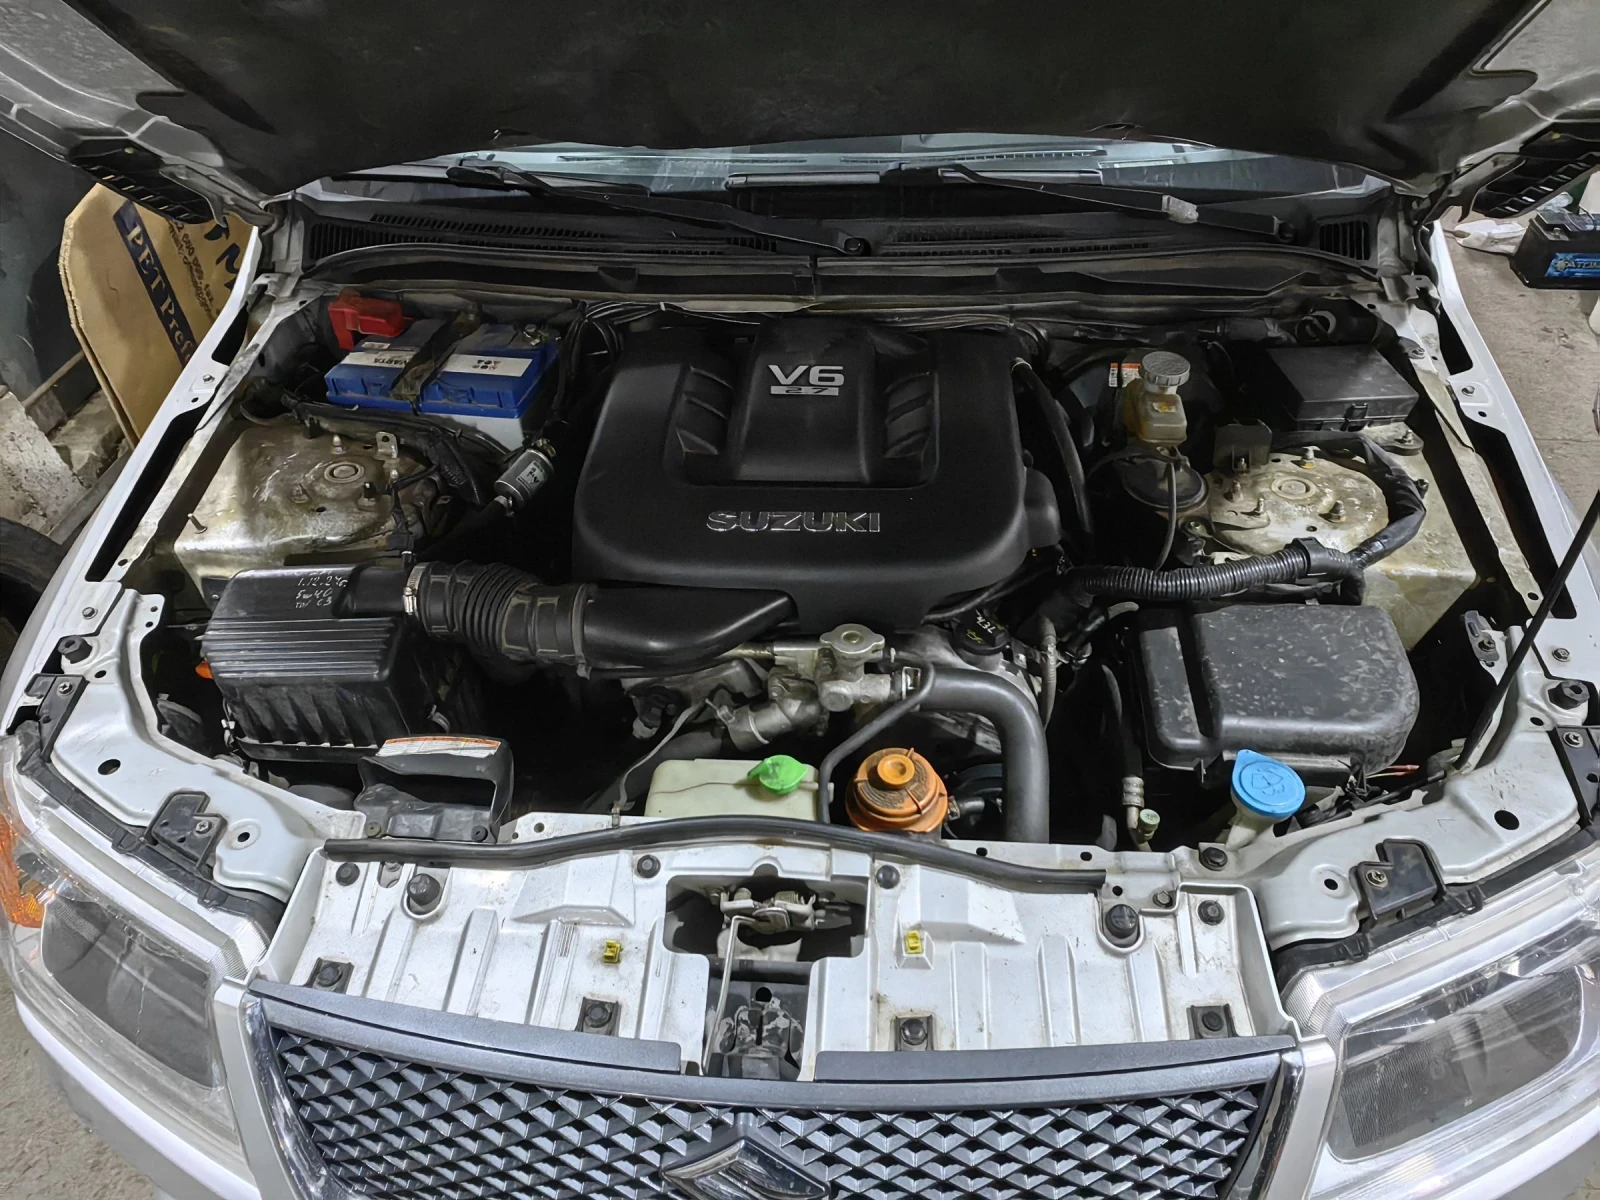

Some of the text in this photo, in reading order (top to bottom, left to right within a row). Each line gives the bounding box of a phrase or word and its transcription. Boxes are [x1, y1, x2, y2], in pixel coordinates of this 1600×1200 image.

[126, 225, 165, 292] PET
[767, 364, 845, 386] V6
[706, 511, 881, 532] SUZUKI
